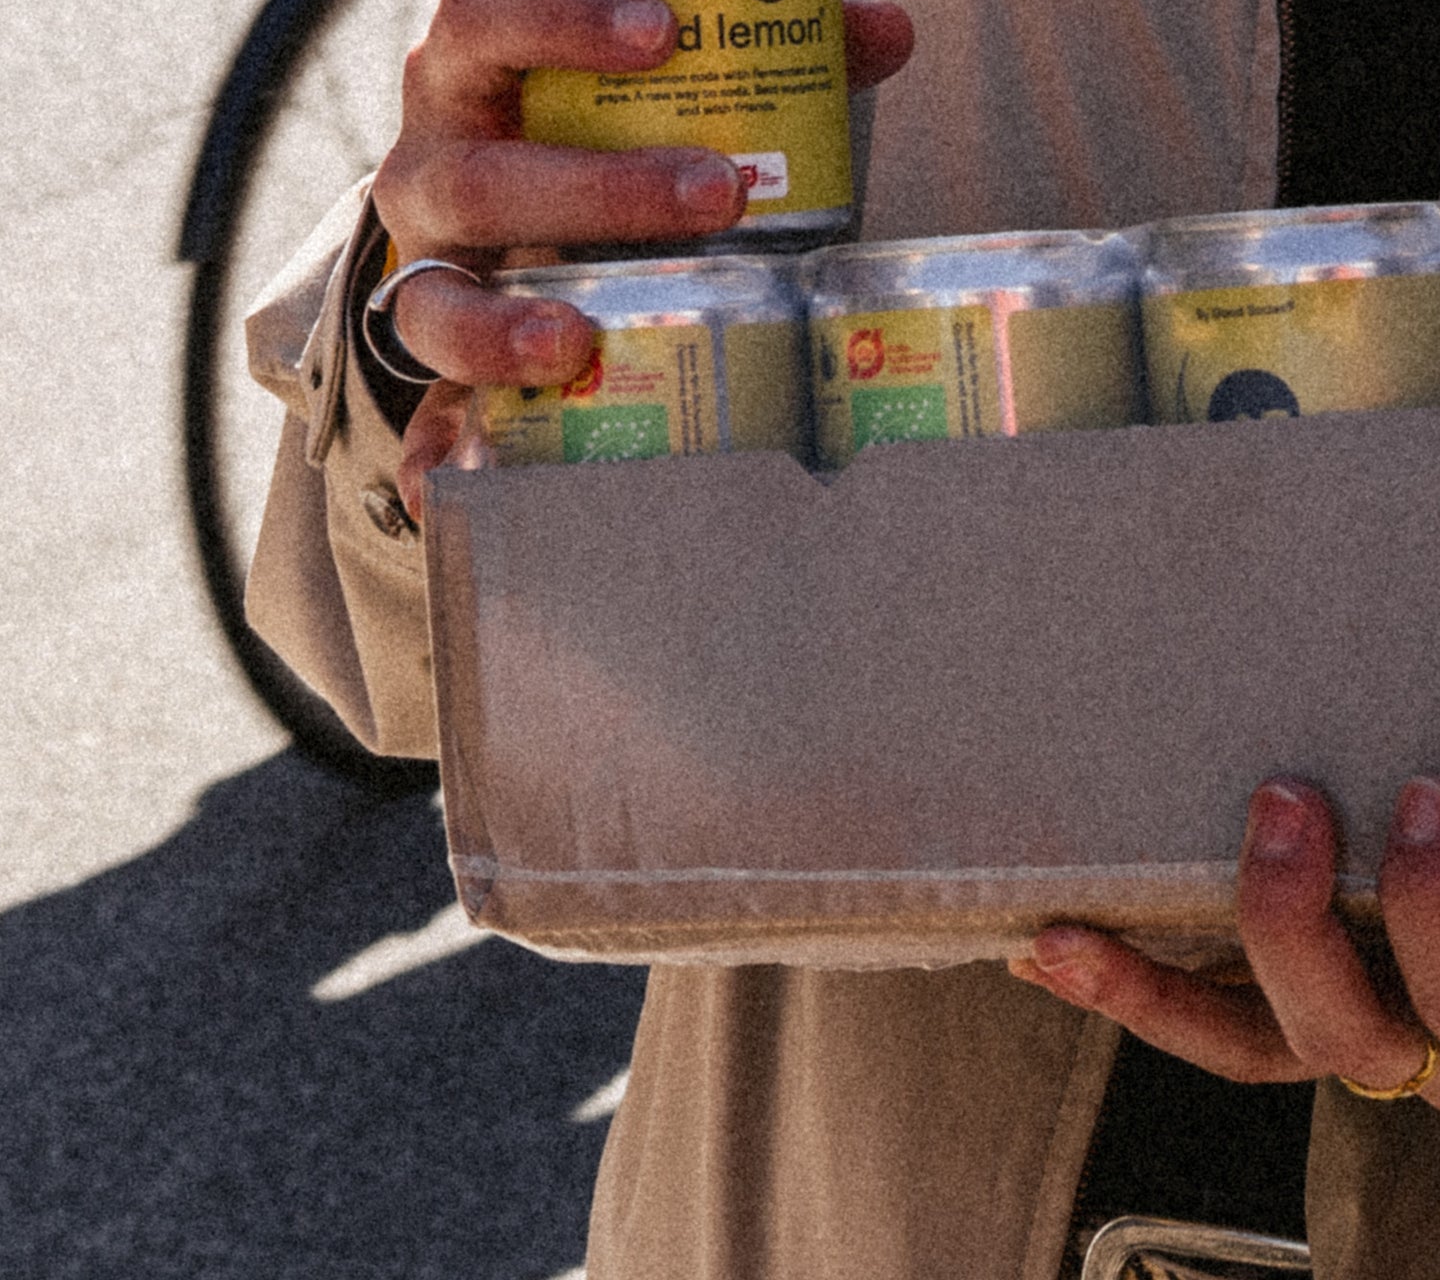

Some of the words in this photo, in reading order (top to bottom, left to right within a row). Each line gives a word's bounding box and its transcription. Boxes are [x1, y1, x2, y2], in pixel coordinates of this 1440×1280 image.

[597, 74, 645, 88] Organic
[649, 74, 687, 84] lemon
[690, 71, 720, 83] soda
[723, 70, 750, 81] with
[677, 104, 701, 116] and
[703, 103, 732, 114] with
